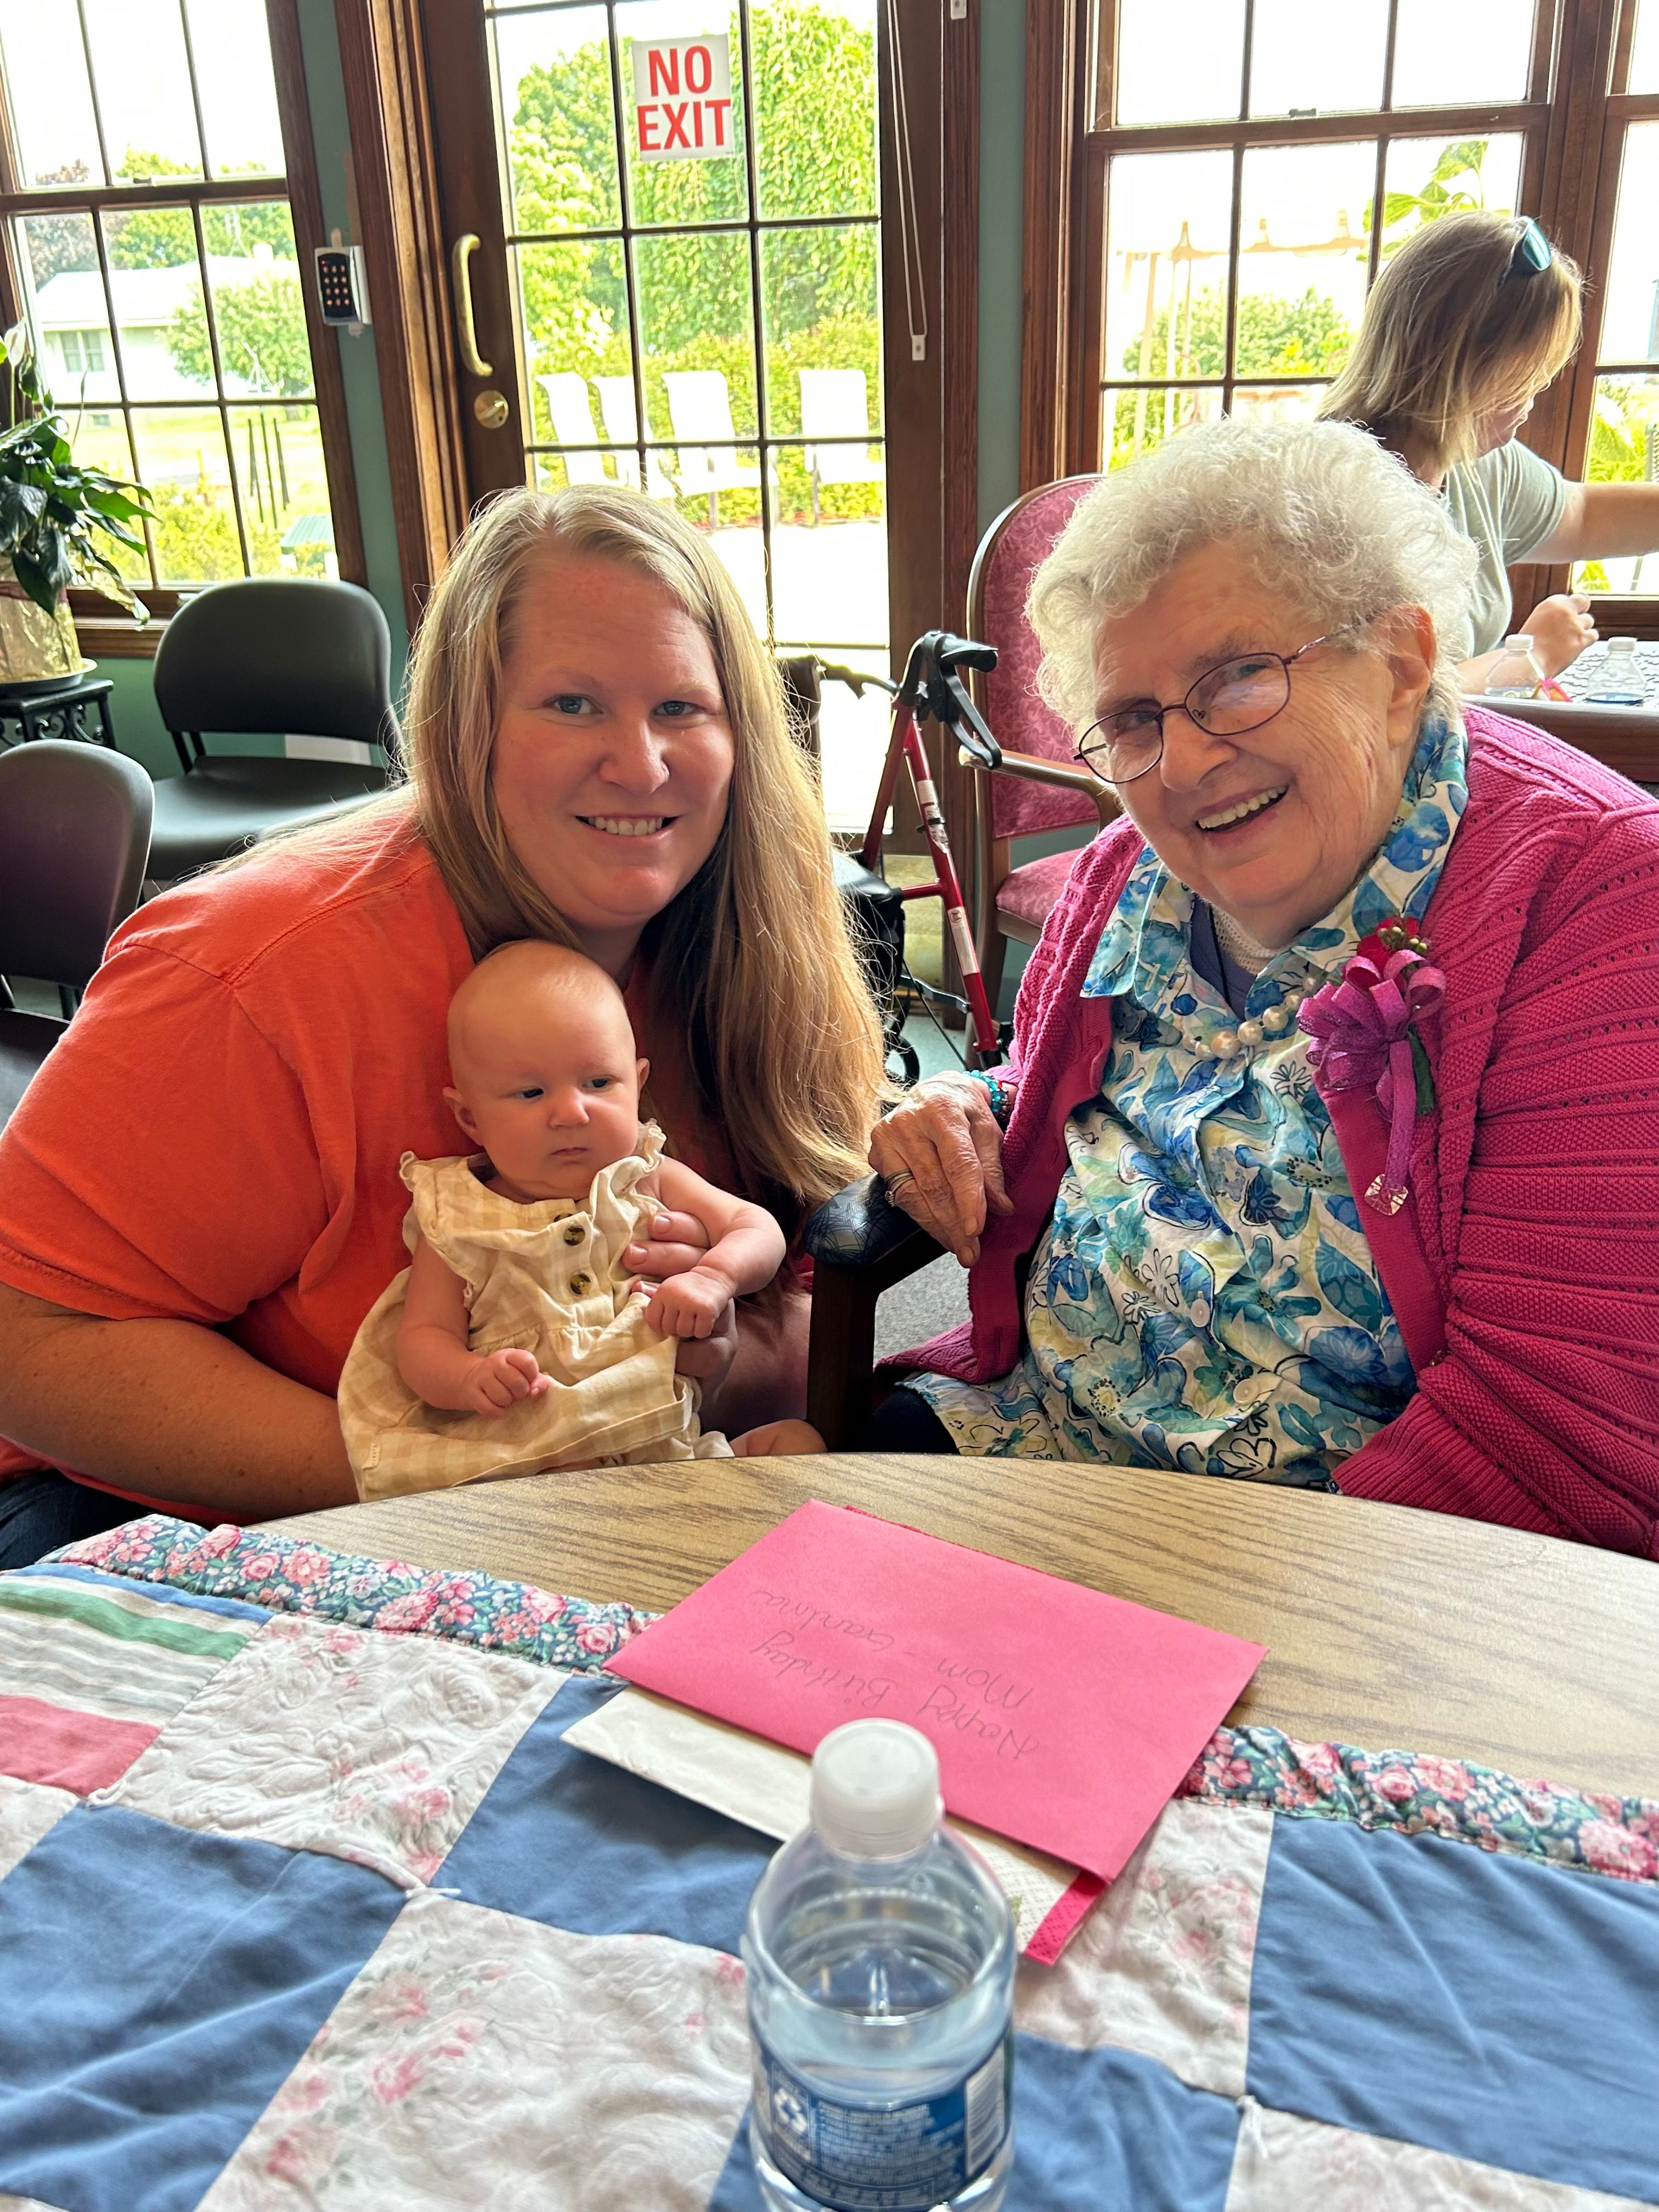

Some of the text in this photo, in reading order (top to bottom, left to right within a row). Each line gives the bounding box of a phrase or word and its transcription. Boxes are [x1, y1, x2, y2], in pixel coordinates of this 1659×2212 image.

[648, 45, 712, 97] NO
[637, 99, 731, 151] EXIT
[748, 1590, 895, 1652] Grandma
[748, 1629, 1040, 1762] Happy Birthday
[936, 1658, 1034, 1711] Mom
